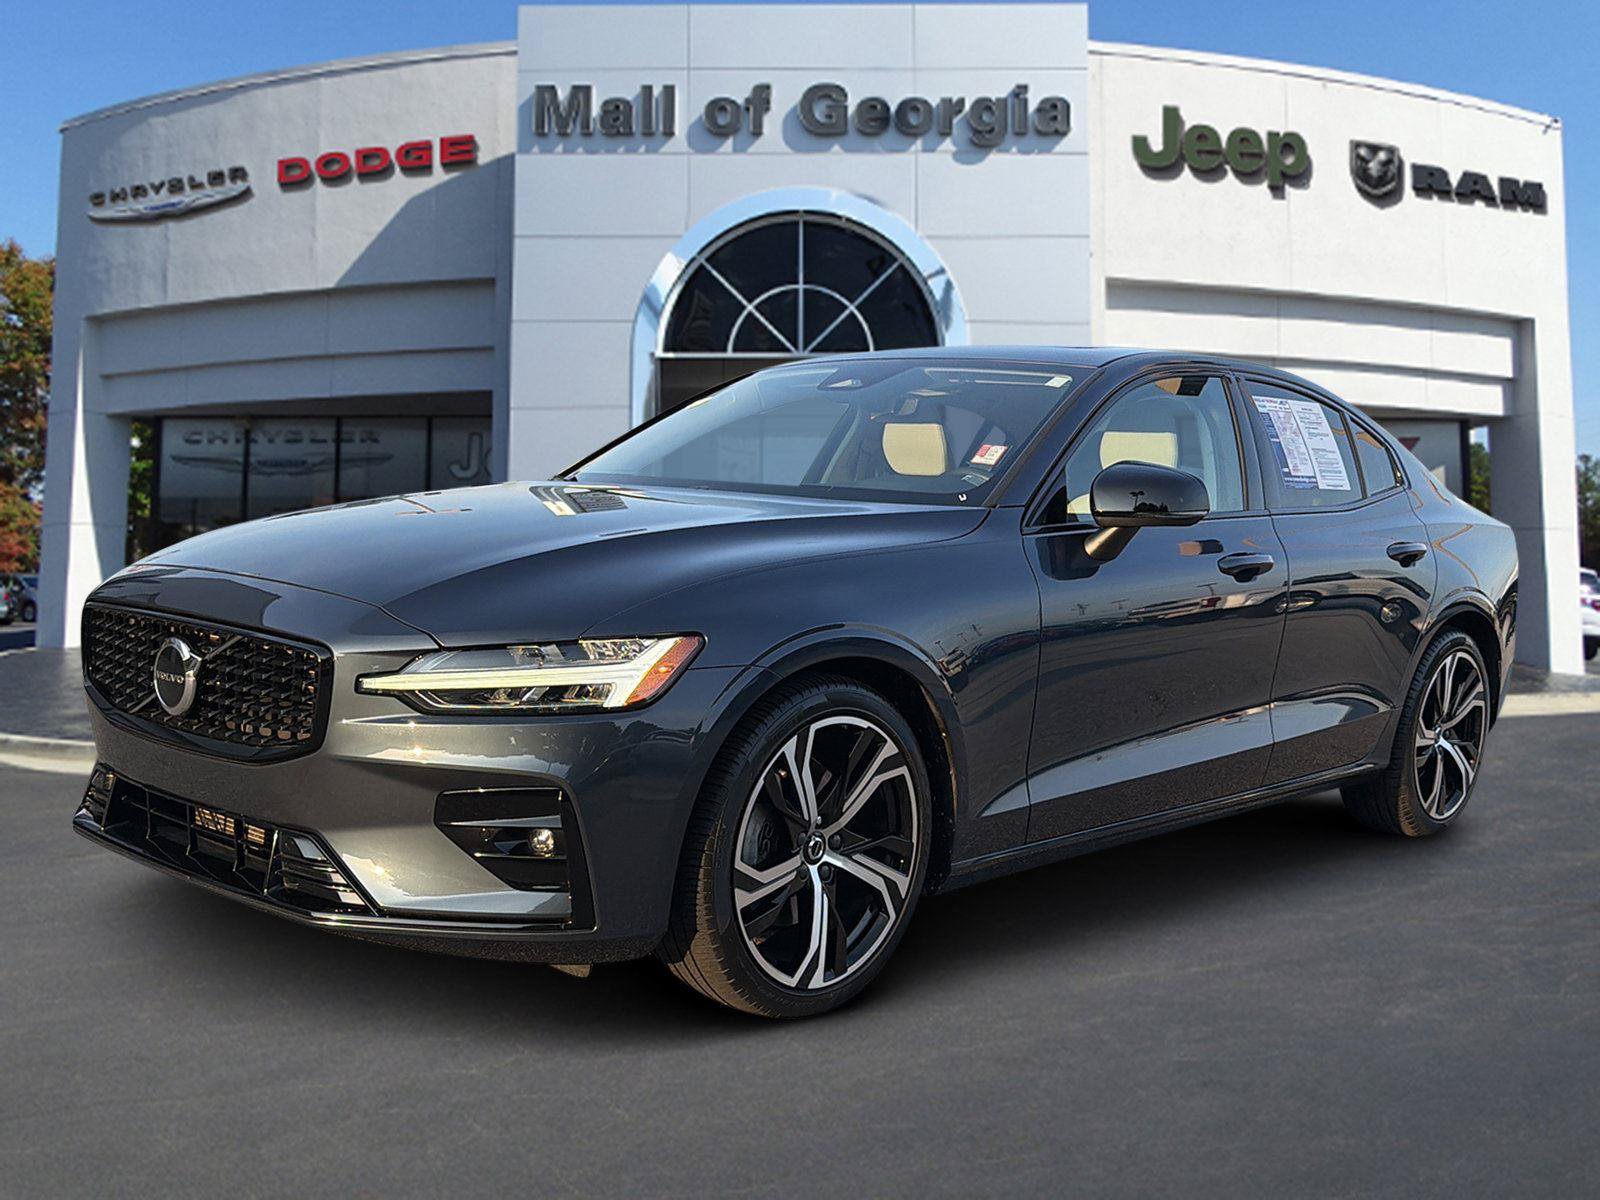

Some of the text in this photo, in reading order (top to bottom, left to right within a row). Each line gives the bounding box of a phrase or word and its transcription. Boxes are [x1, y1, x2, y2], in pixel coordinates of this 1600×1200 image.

[532, 82, 1073, 148] Mall of Georgia
[277, 134, 478, 188] DODGE
[1132, 105, 1309, 197] Jeep
[89, 165, 249, 207] CHRYSLER
[1411, 163, 1547, 213] RAM
[183, 429, 381, 444] CHRYSLER
[156, 670, 185, 685] VOLVO
